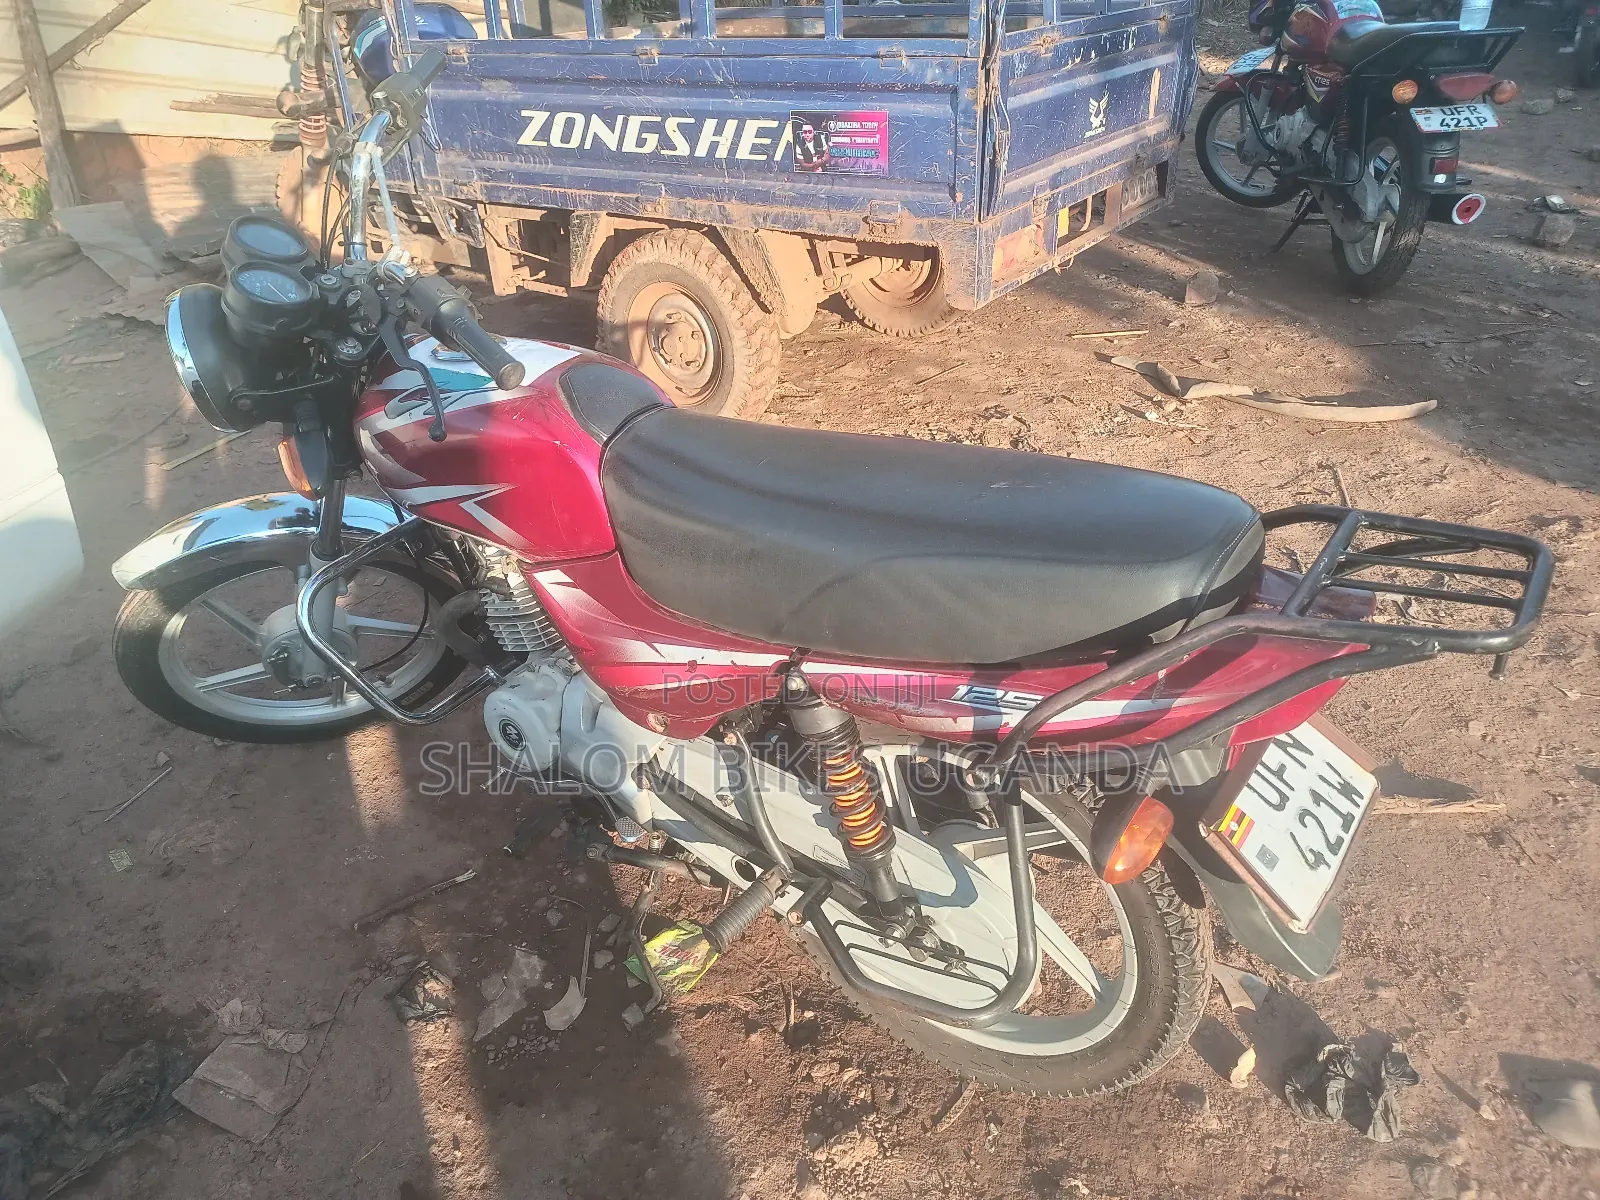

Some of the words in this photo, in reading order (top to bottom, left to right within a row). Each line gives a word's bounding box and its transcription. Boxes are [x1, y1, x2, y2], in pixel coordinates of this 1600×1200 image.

[1440, 105, 1482, 116] UFR
[1440, 116, 1488, 129] 421P
[951, 684, 1045, 711] 125
[1289, 761, 1364, 872] 421W
